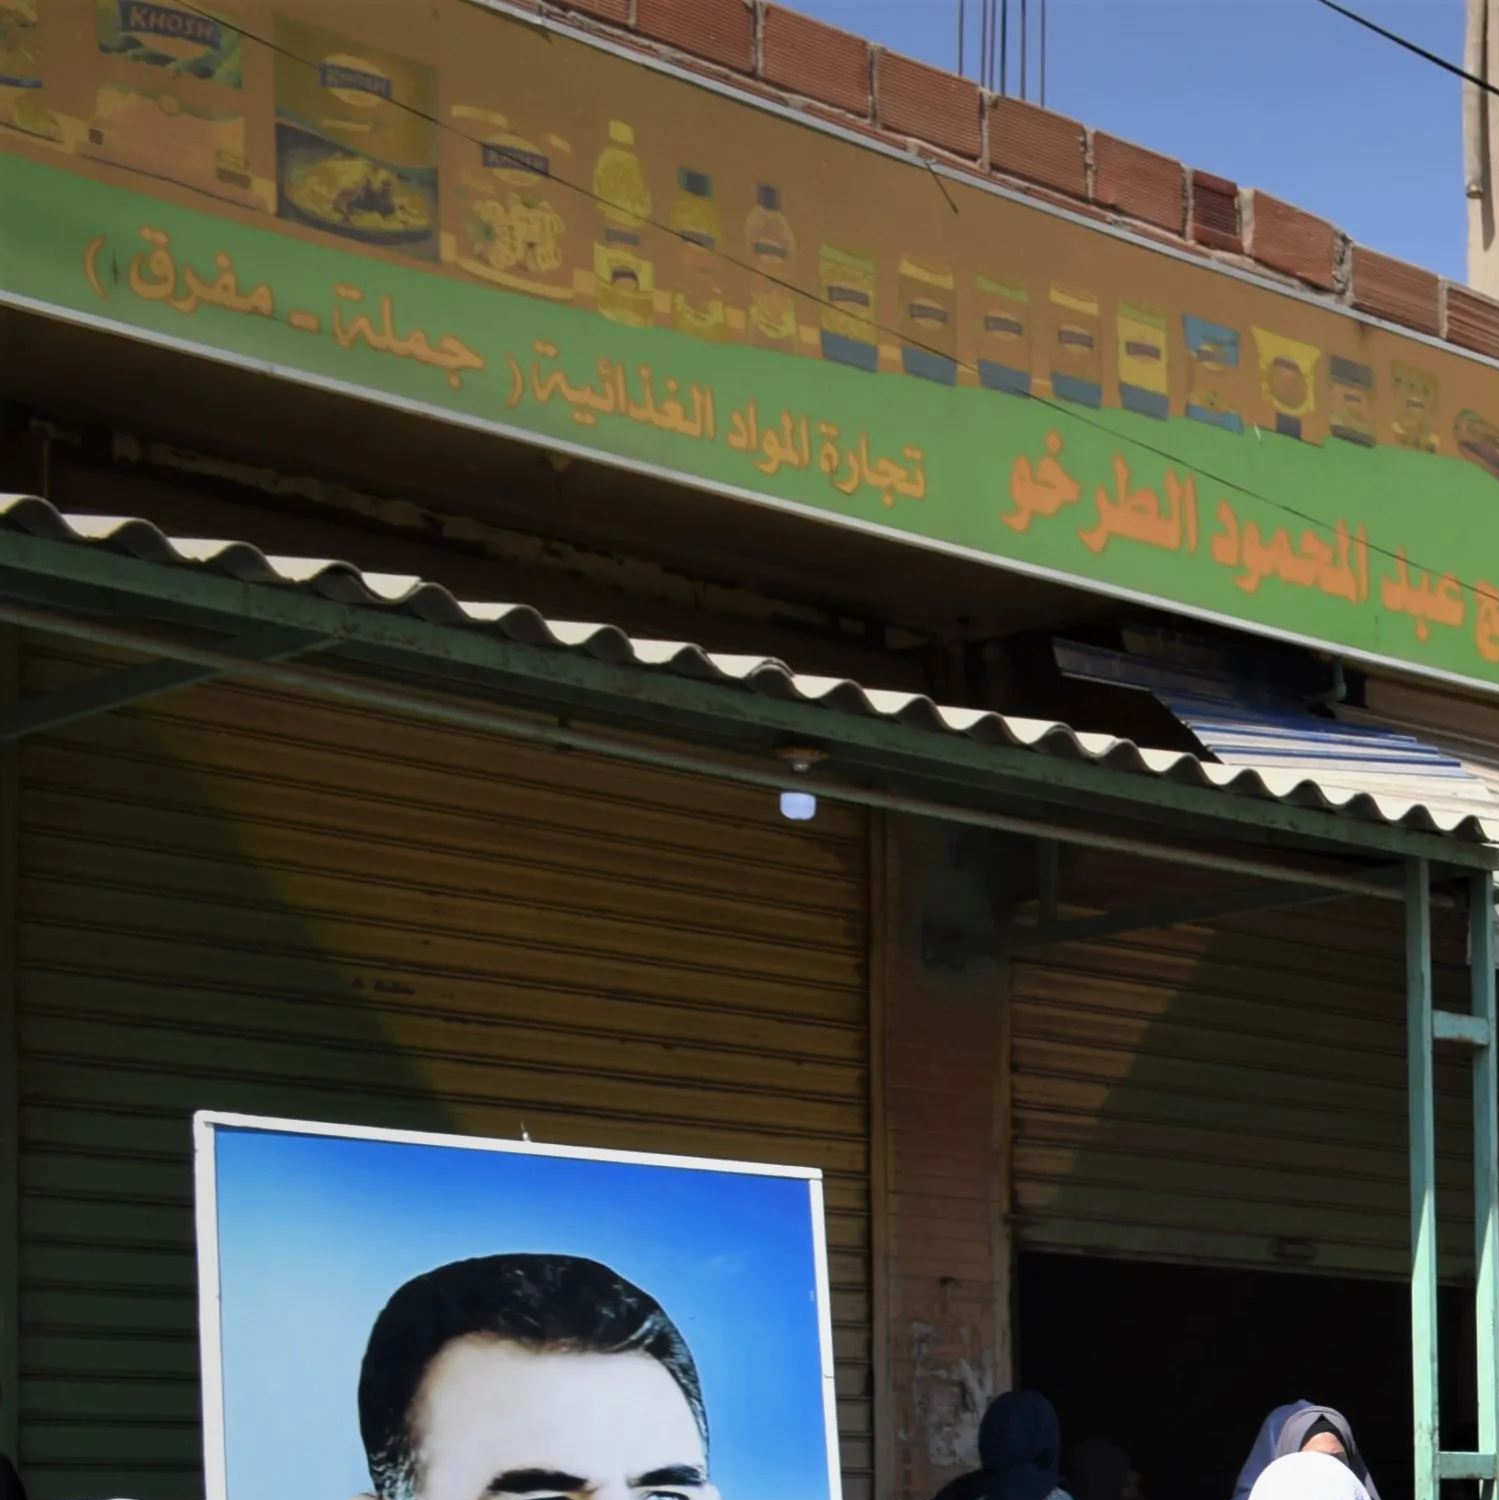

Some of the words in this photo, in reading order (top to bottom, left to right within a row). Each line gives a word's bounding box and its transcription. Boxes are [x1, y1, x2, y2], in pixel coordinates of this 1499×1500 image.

[128, 6, 215, 43] KHOSH
[128, 224, 274, 316] مفرق
[727, 401, 810, 475] المواد
[820, 423, 925, 506] تجارة
[1381, 547, 1466, 642] عبد
